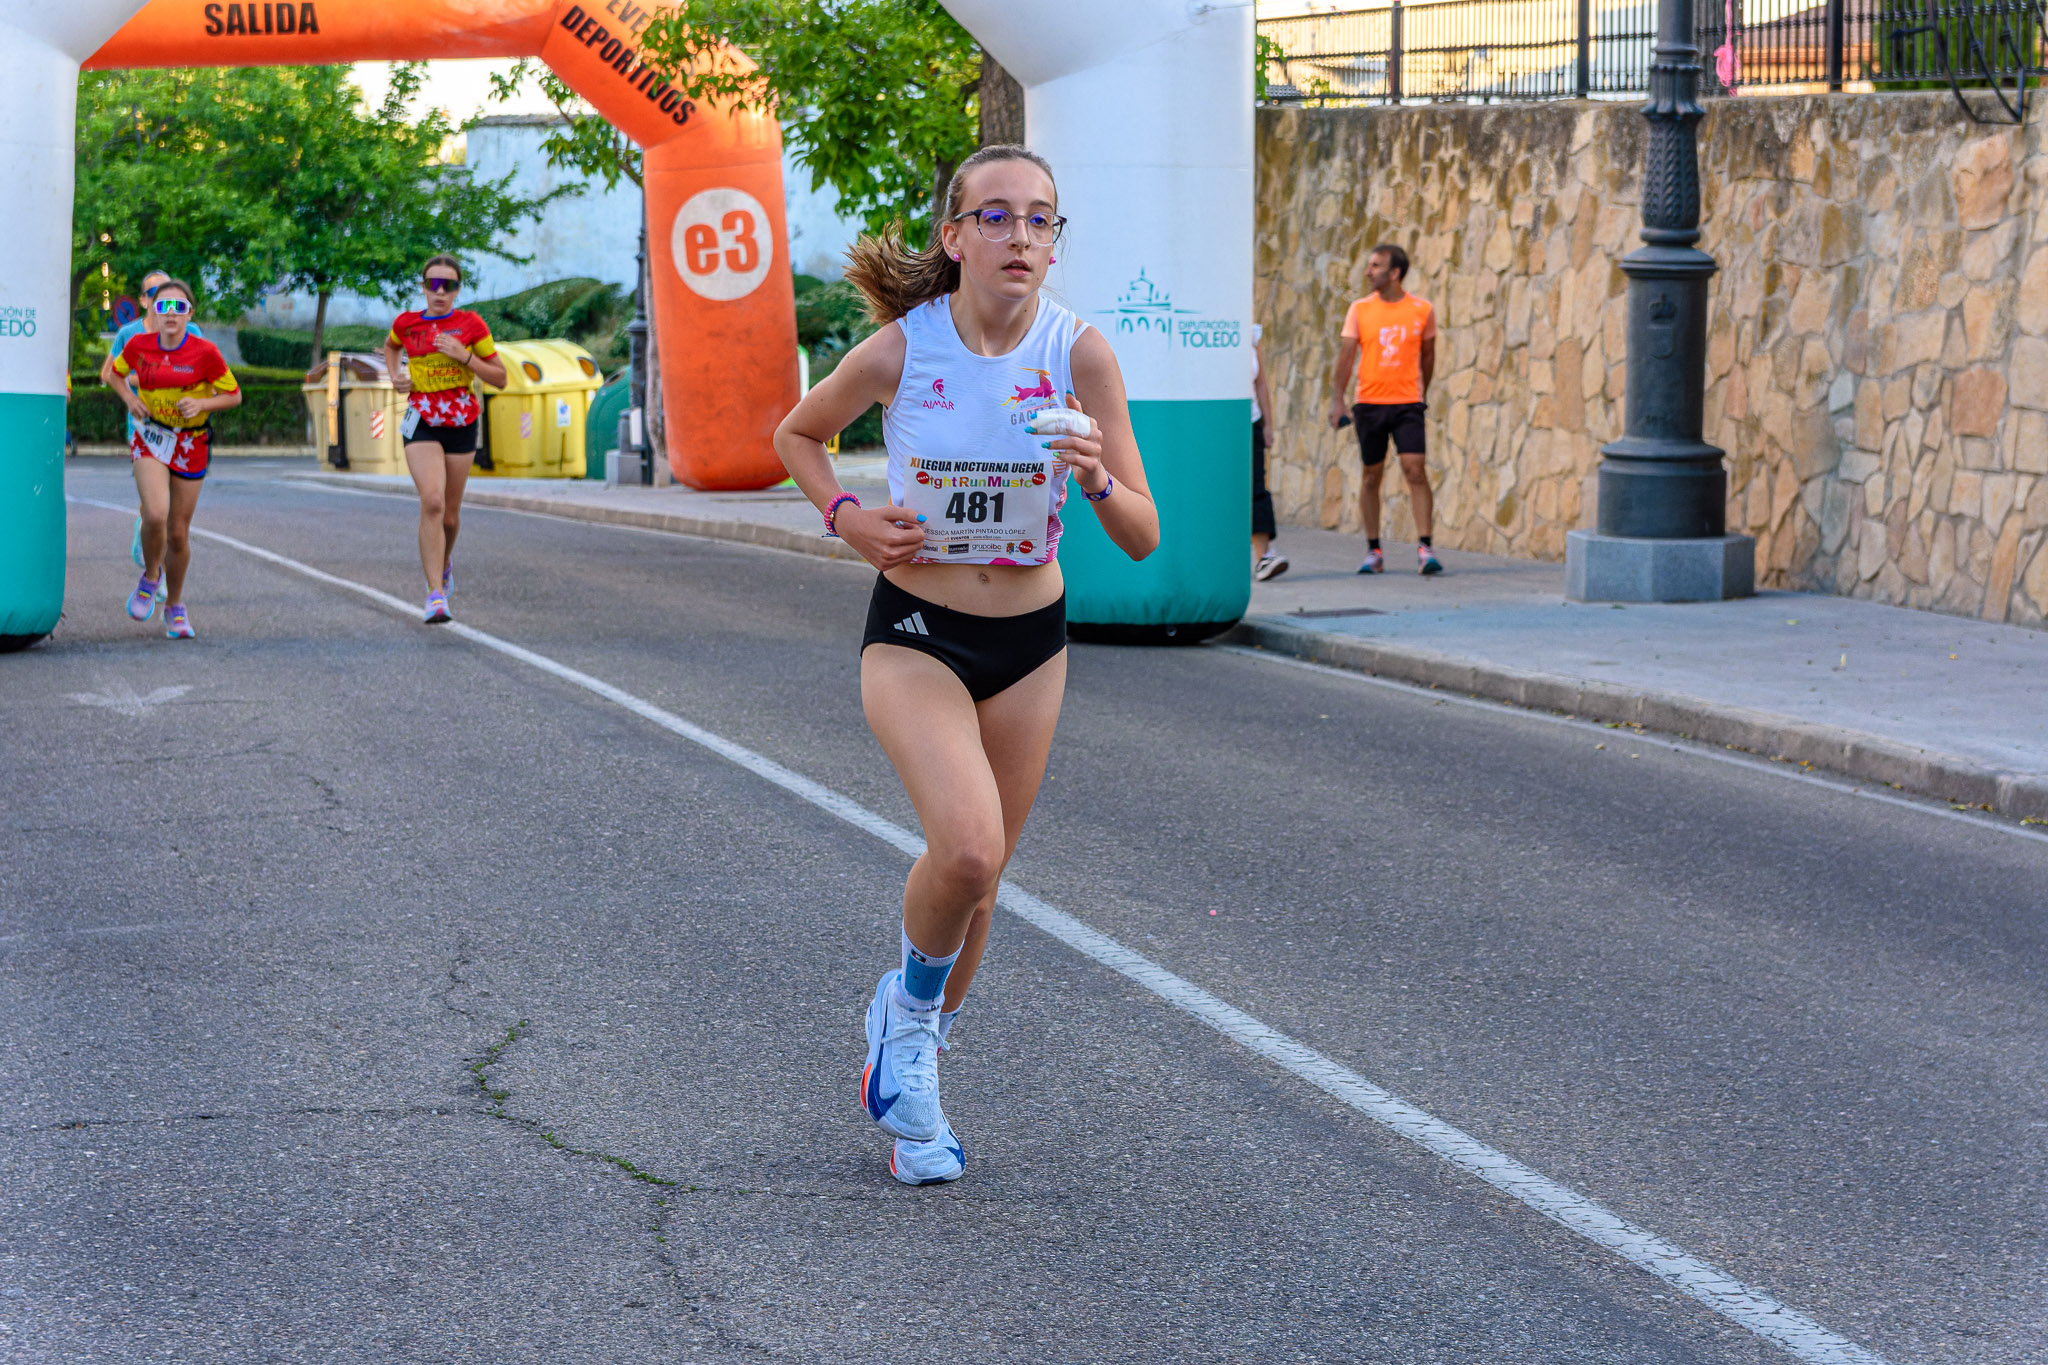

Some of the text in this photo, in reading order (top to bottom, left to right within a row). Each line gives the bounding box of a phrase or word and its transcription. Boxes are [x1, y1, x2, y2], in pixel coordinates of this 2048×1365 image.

[204, 2, 319, 36] SALIDA
[559, 4, 697, 125] DEPORTIVOS
[685, 210, 758, 275] e3
[25, 307, 36, 318] DE
[1178, 331, 1241, 348] TOLEDO
[922, 400, 955, 410] AIMAR
[144, 429, 164, 446] 490
[910, 456, 1045, 473] XI LEGUA NOCTURNA UGENA
[945, 490, 1005, 524] 481
[924, 528, 950, 536] JESSICA
[950, 528, 975, 536] MARTÍN
